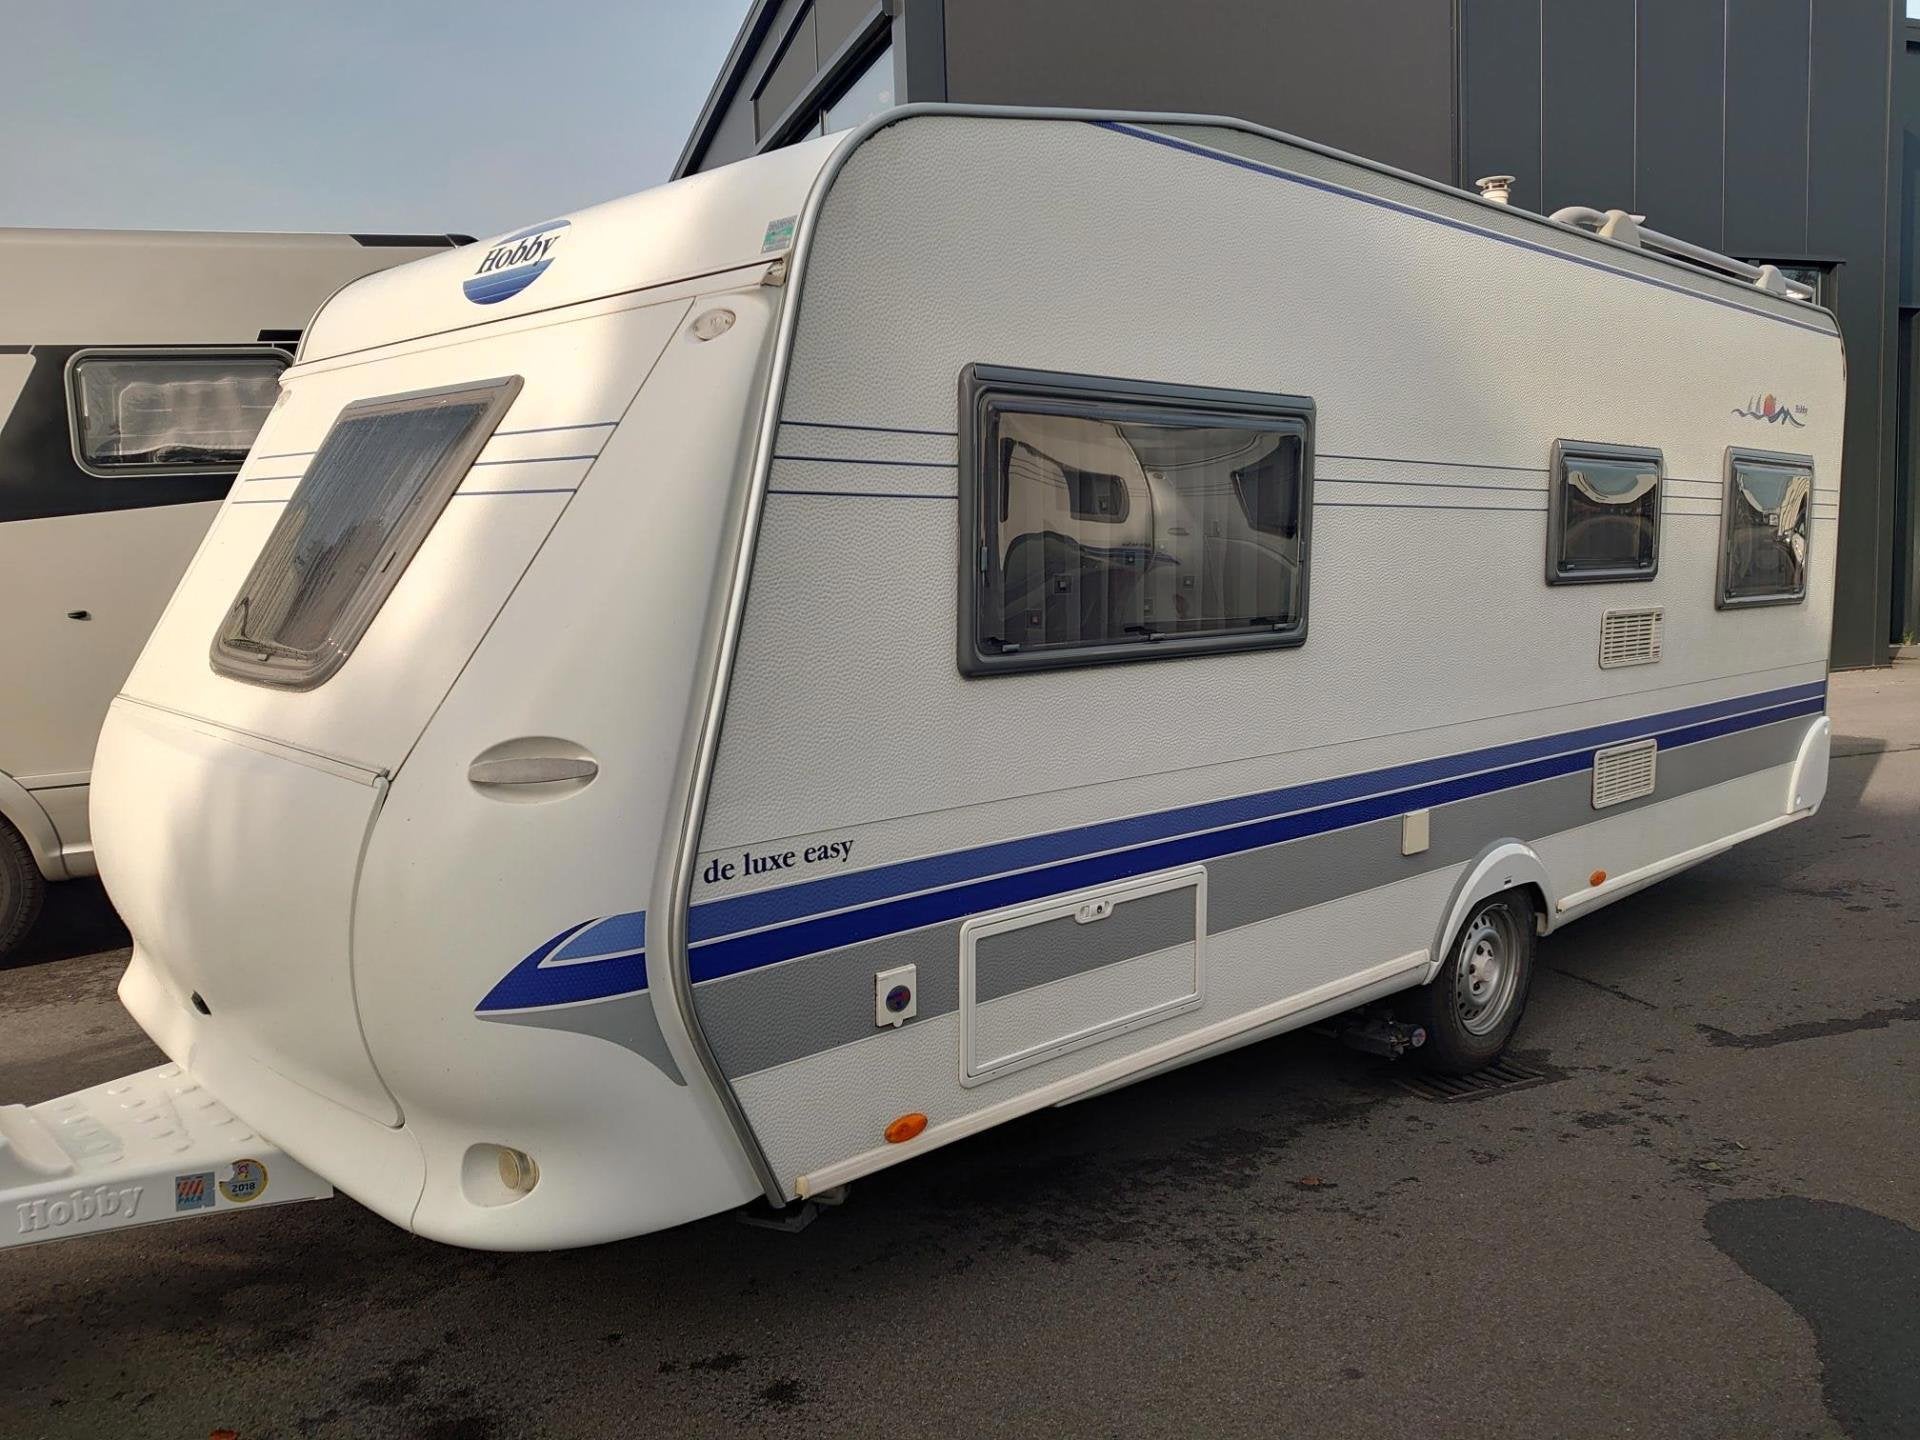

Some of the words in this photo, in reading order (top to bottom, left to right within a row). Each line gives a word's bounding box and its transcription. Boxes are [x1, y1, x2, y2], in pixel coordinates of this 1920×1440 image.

[475, 233, 560, 275] Hobby
[703, 858, 735, 884] de
[743, 852, 796, 876] luxe
[803, 839, 854, 862] easy
[231, 1182, 256, 1193] 2018
[16, 1186, 145, 1233] Hobby
